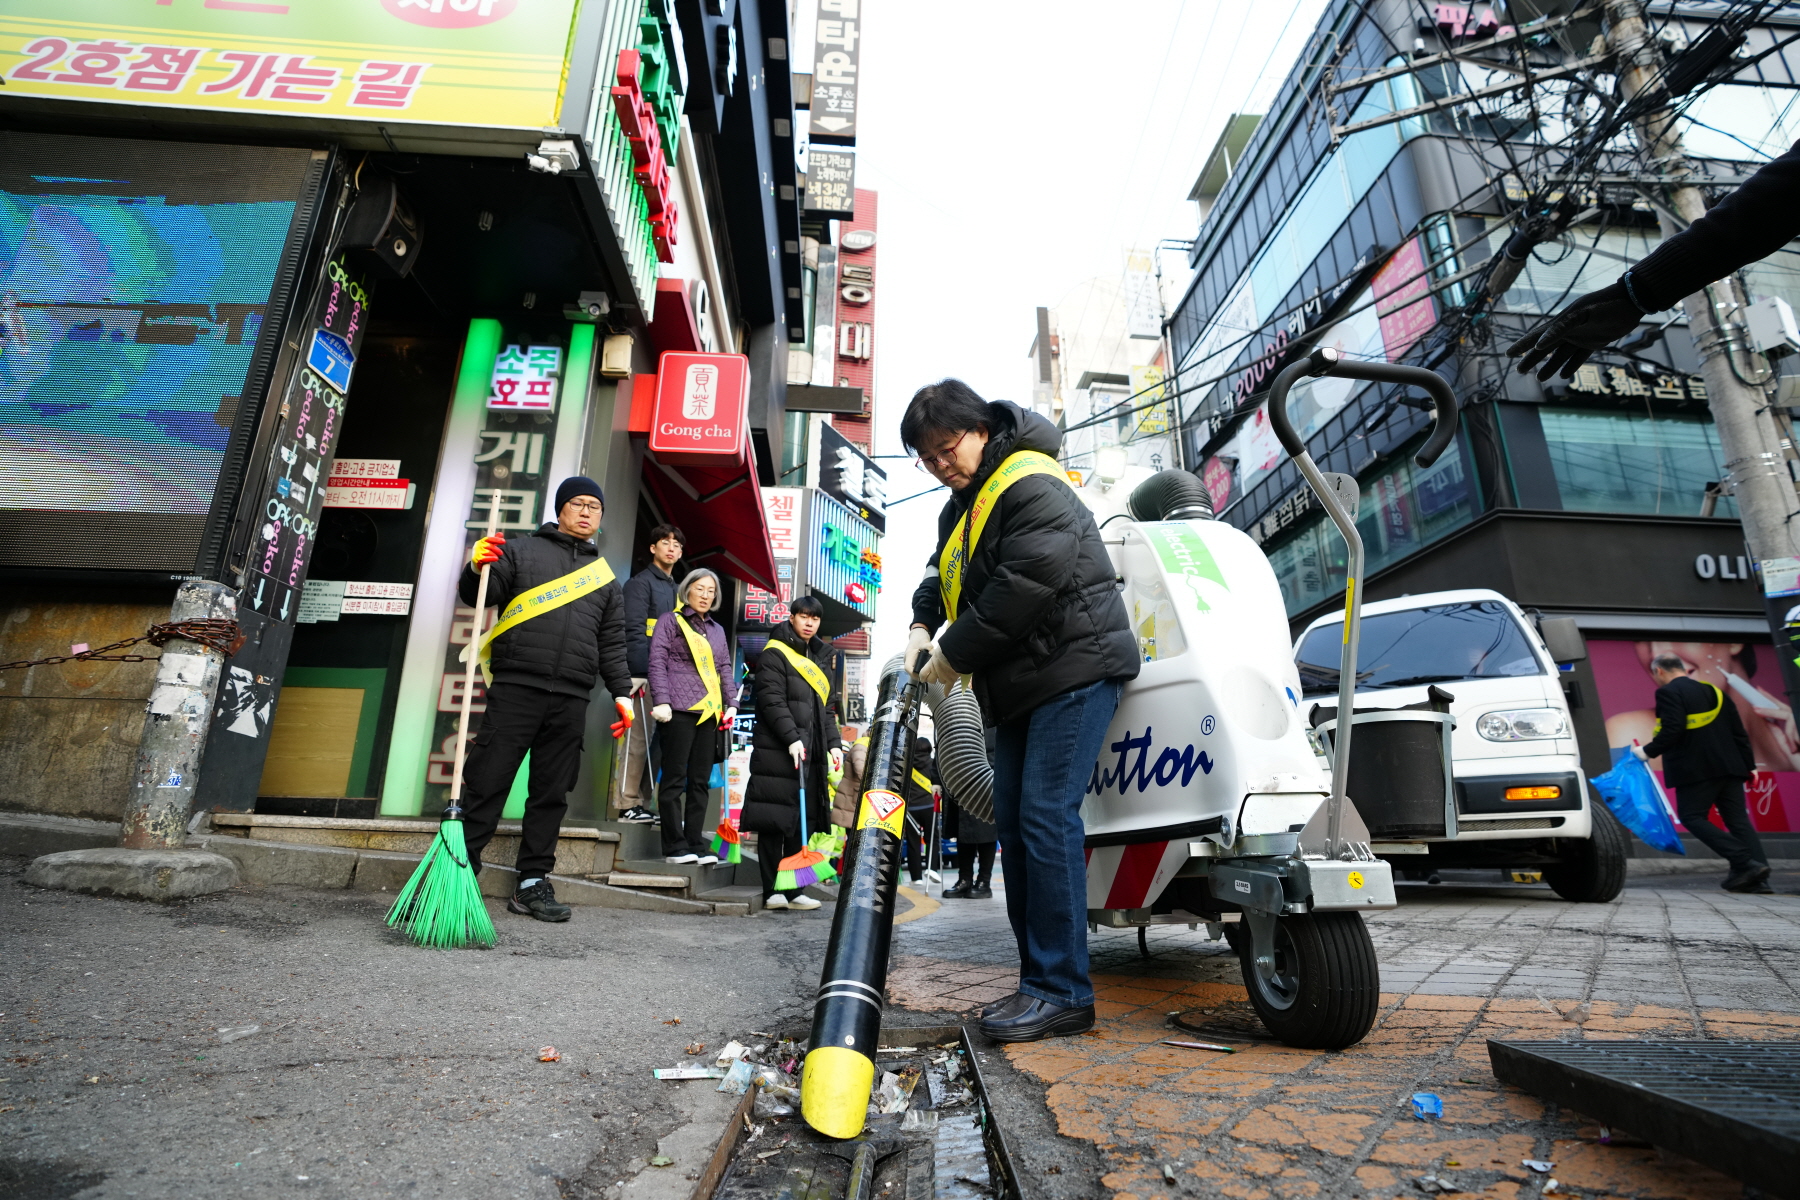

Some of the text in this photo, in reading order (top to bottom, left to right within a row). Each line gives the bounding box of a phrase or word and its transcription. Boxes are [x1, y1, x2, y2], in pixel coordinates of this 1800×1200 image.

[9, 37, 425, 108] 2호점 가는 길
[826, 98, 855, 113] 호프
[846, 233, 873, 245] NEW
[324, 355, 336, 375] 7
[494, 348, 557, 379] 소주
[493, 378, 552, 409] 호프
[660, 423, 732, 441] Gong cha
[367, 462, 396, 476] 금지업소
[465, 430, 547, 532] 게코
[349, 490, 367, 505] 오전
[767, 495, 795, 550] 첼로
[1159, 527, 1199, 577] electric
[349, 584, 365, 594] 청소년
[389, 586, 411, 596] 금지업소
[344, 602, 361, 612] 신분증
[385, 603, 408, 612] 출입금지
[745, 603, 792, 623] 타운
[1086, 725, 1214, 796] utton
